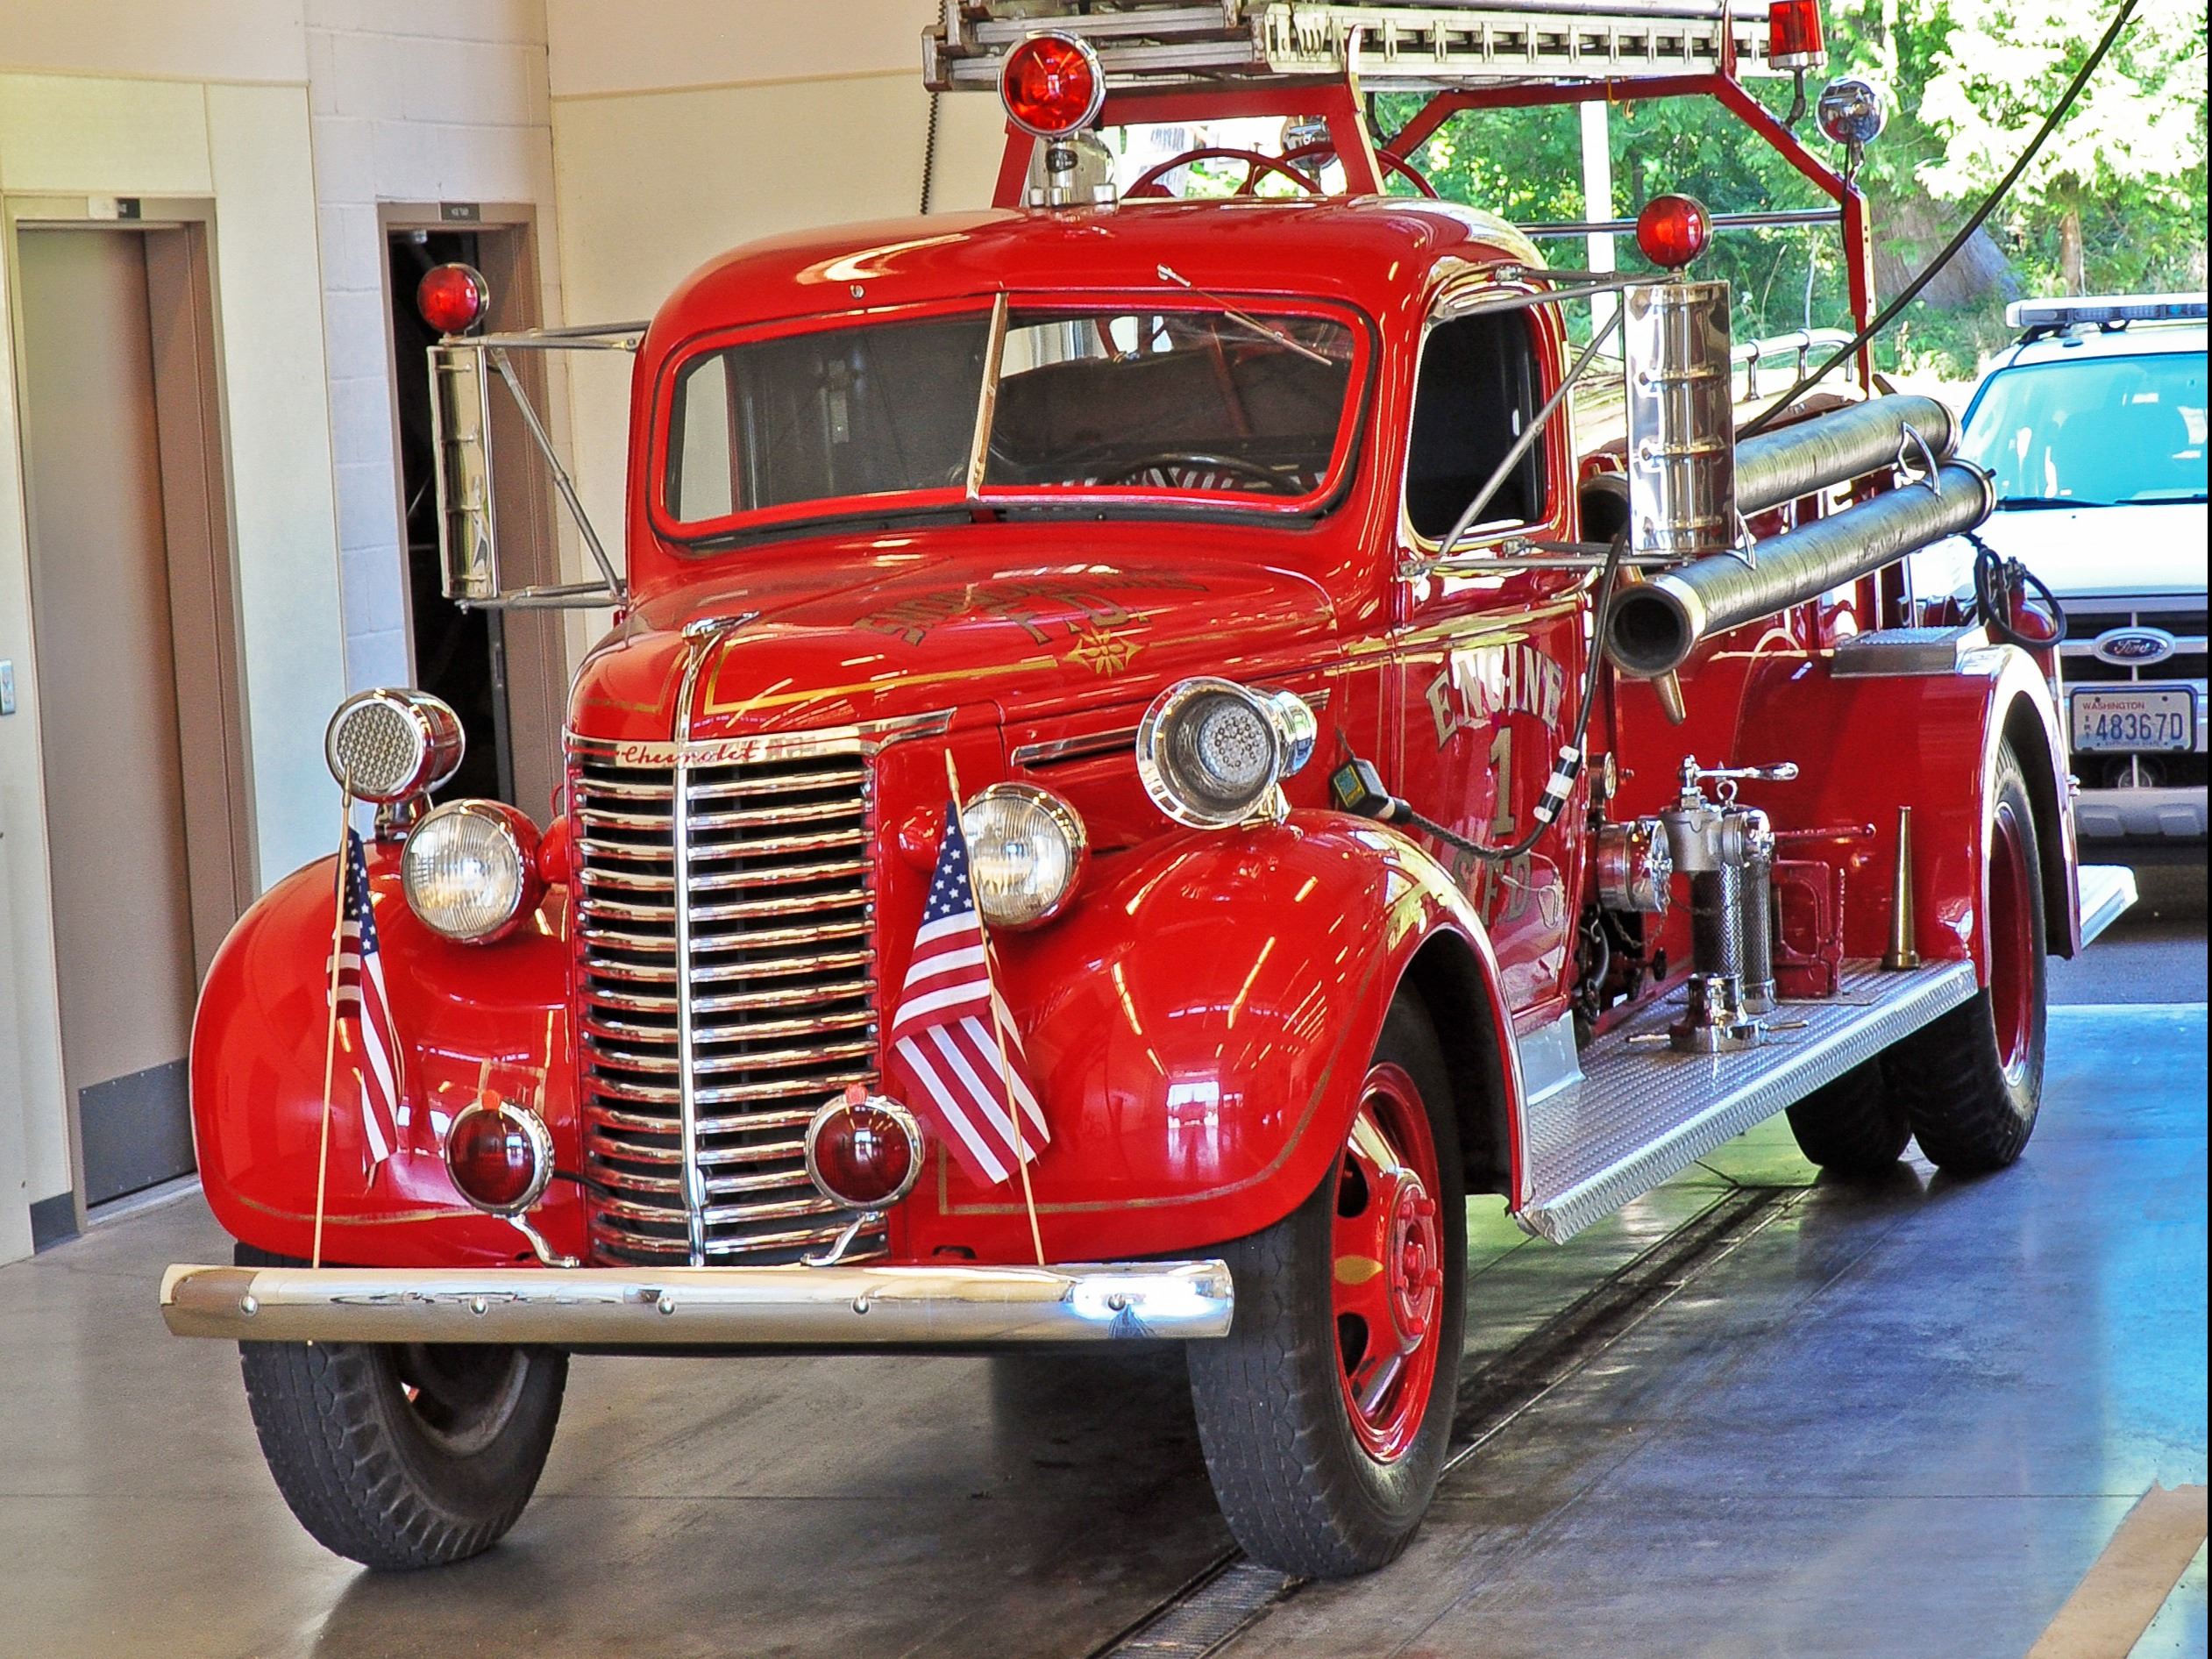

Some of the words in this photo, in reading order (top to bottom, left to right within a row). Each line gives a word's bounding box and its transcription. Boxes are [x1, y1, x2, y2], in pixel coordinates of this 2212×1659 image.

[2114, 639, 2150, 654] Ford
[1426, 644, 1562, 750] ENGINE
[2082, 701, 2145, 710] WASHINGTON
[2095, 712, 2183, 741] 48367D
[623, 740, 757, 765] Chevrolet
[1490, 725, 1515, 835] 1
